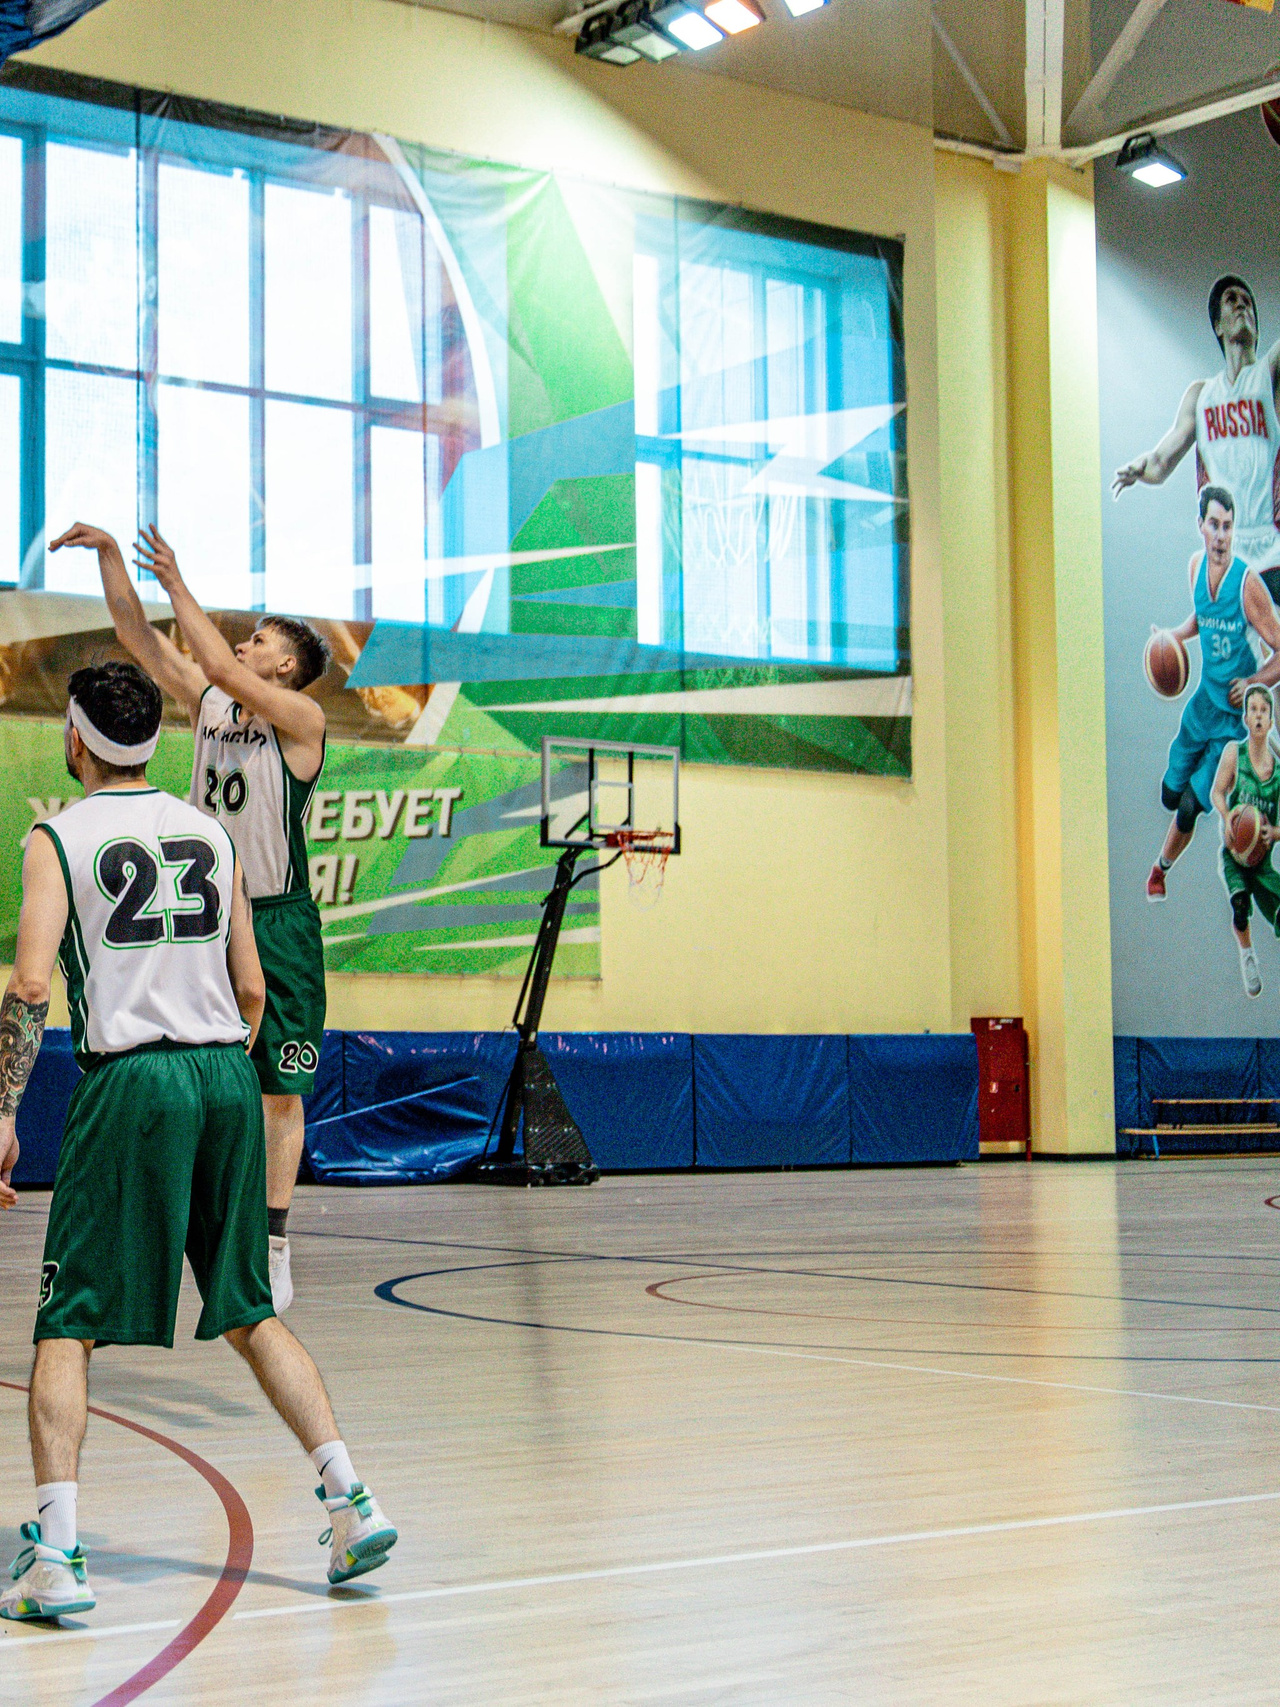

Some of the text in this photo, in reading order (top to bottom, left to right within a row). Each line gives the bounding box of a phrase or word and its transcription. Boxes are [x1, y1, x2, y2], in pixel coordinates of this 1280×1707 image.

[1204, 398, 1269, 442] RUSSIA
[1211, 634, 1232, 660] 30
[204, 766, 249, 816] 20
[307, 787, 462, 841] ЕБУЕТ
[94, 834, 224, 950] 23
[280, 1041, 319, 1074] 20
